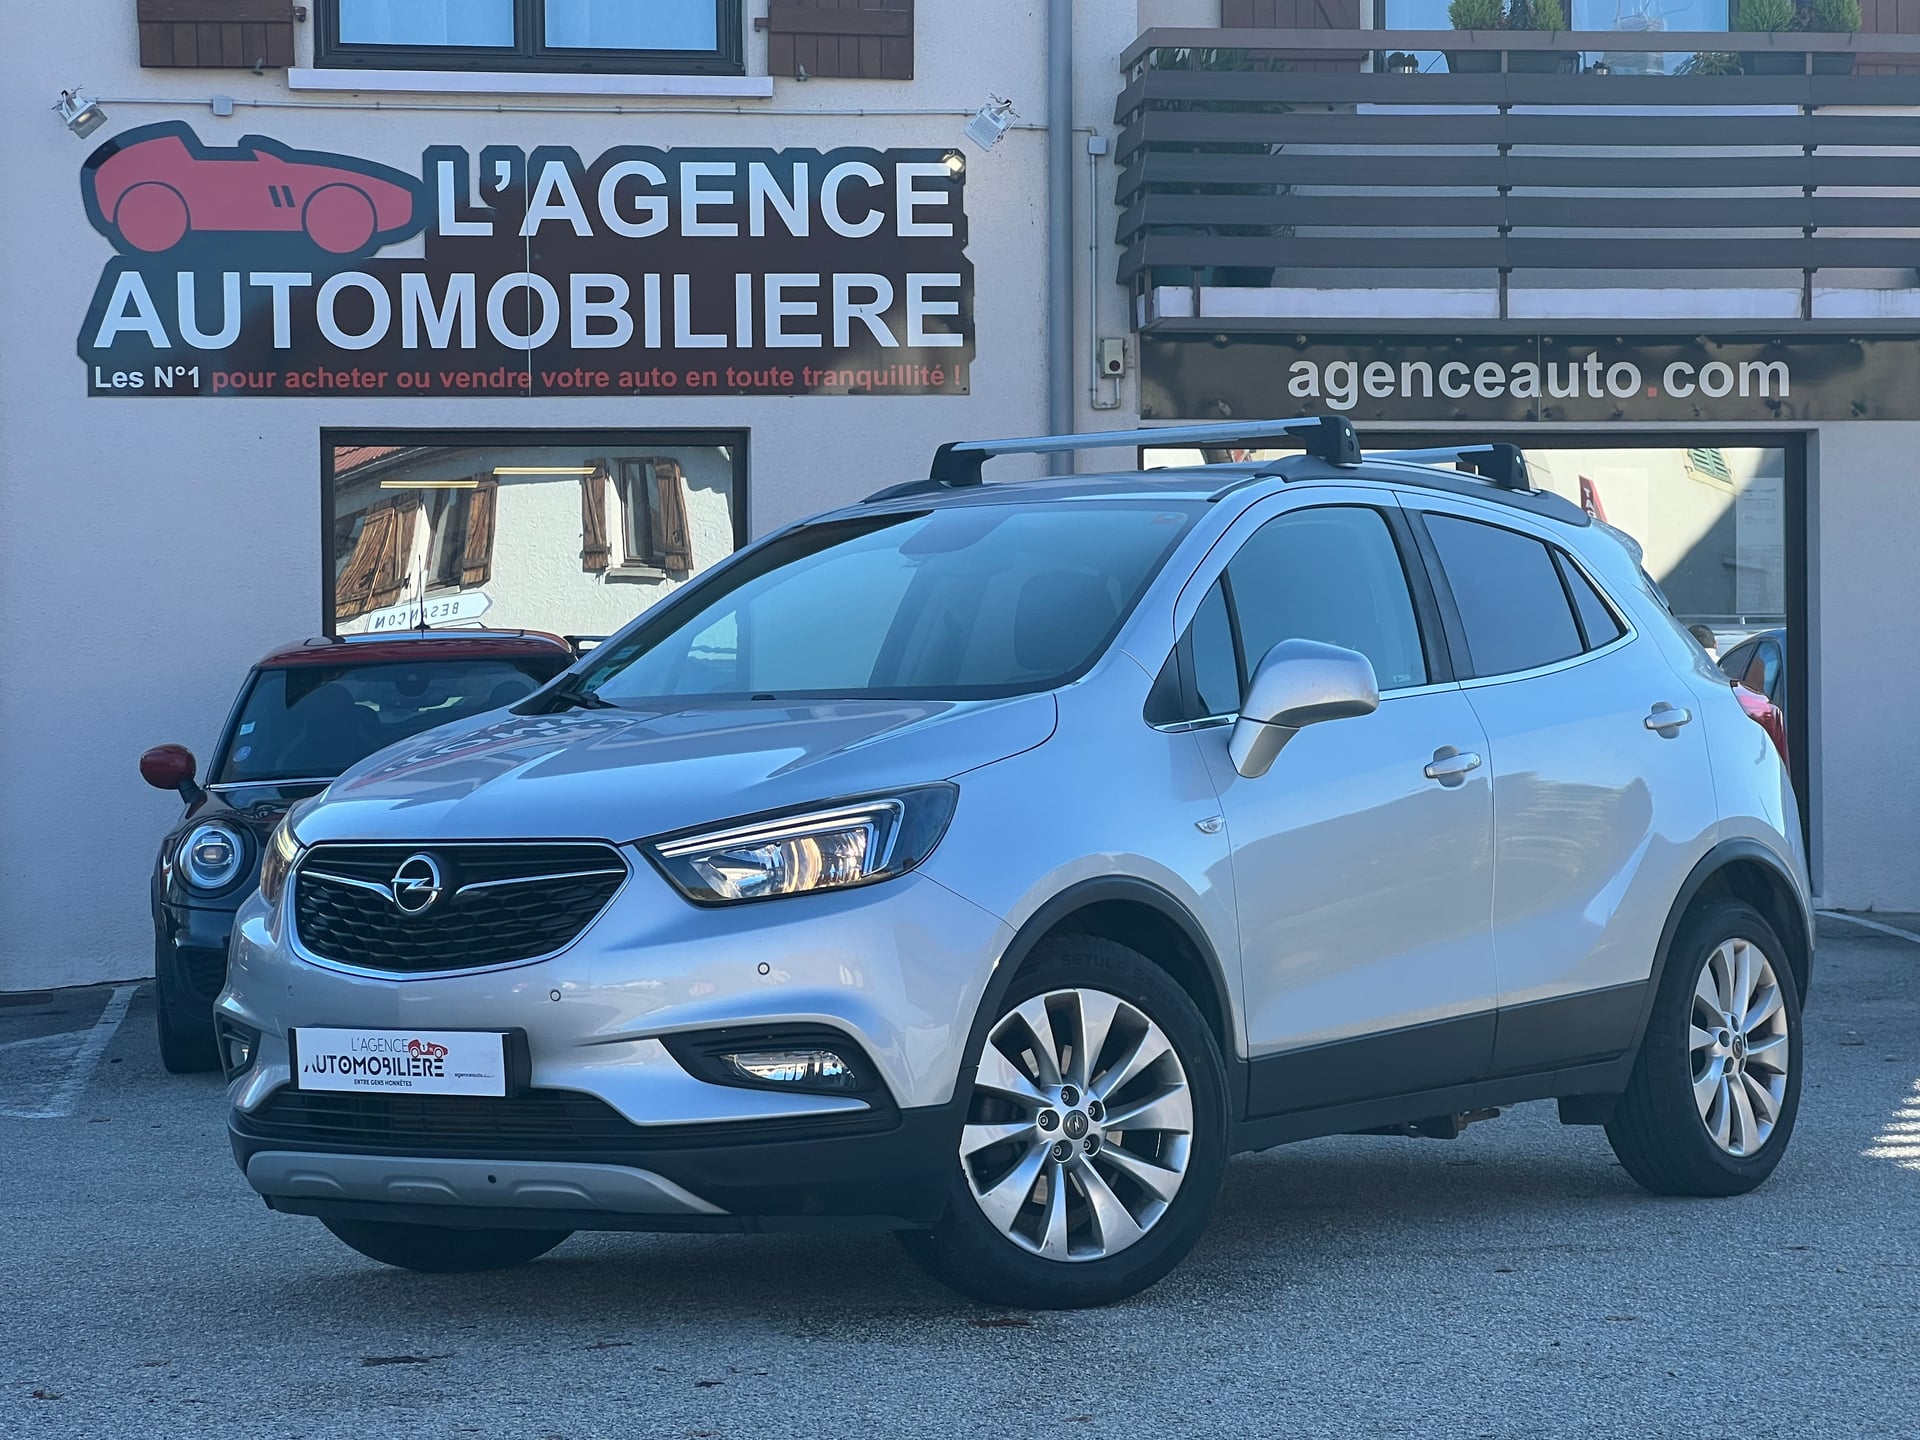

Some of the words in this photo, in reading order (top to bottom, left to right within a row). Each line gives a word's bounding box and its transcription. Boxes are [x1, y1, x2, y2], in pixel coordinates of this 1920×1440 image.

[437, 160, 954, 239] L'AGENCE
[93, 271, 964, 351] AUTOMOBILIERE
[94, 366, 147, 388] Les
[153, 366, 200, 388] N°1
[211, 368, 278, 393] pour
[284, 366, 388, 389] acheter
[396, 371, 431, 389] ou
[439, 366, 532, 389] vendre
[541, 368, 610, 388] votre
[618, 367, 678, 388] auto
[685, 370, 719, 388] en
[726, 367, 795, 388] toute
[802, 364, 945, 393] tranquillité
[1288, 351, 1791, 411] agenceauto.com
[351, 1037, 409, 1053] L'AGENCE
[353, 1078, 370, 1086] ENTRE
[370, 1079, 385, 1087] GENS
